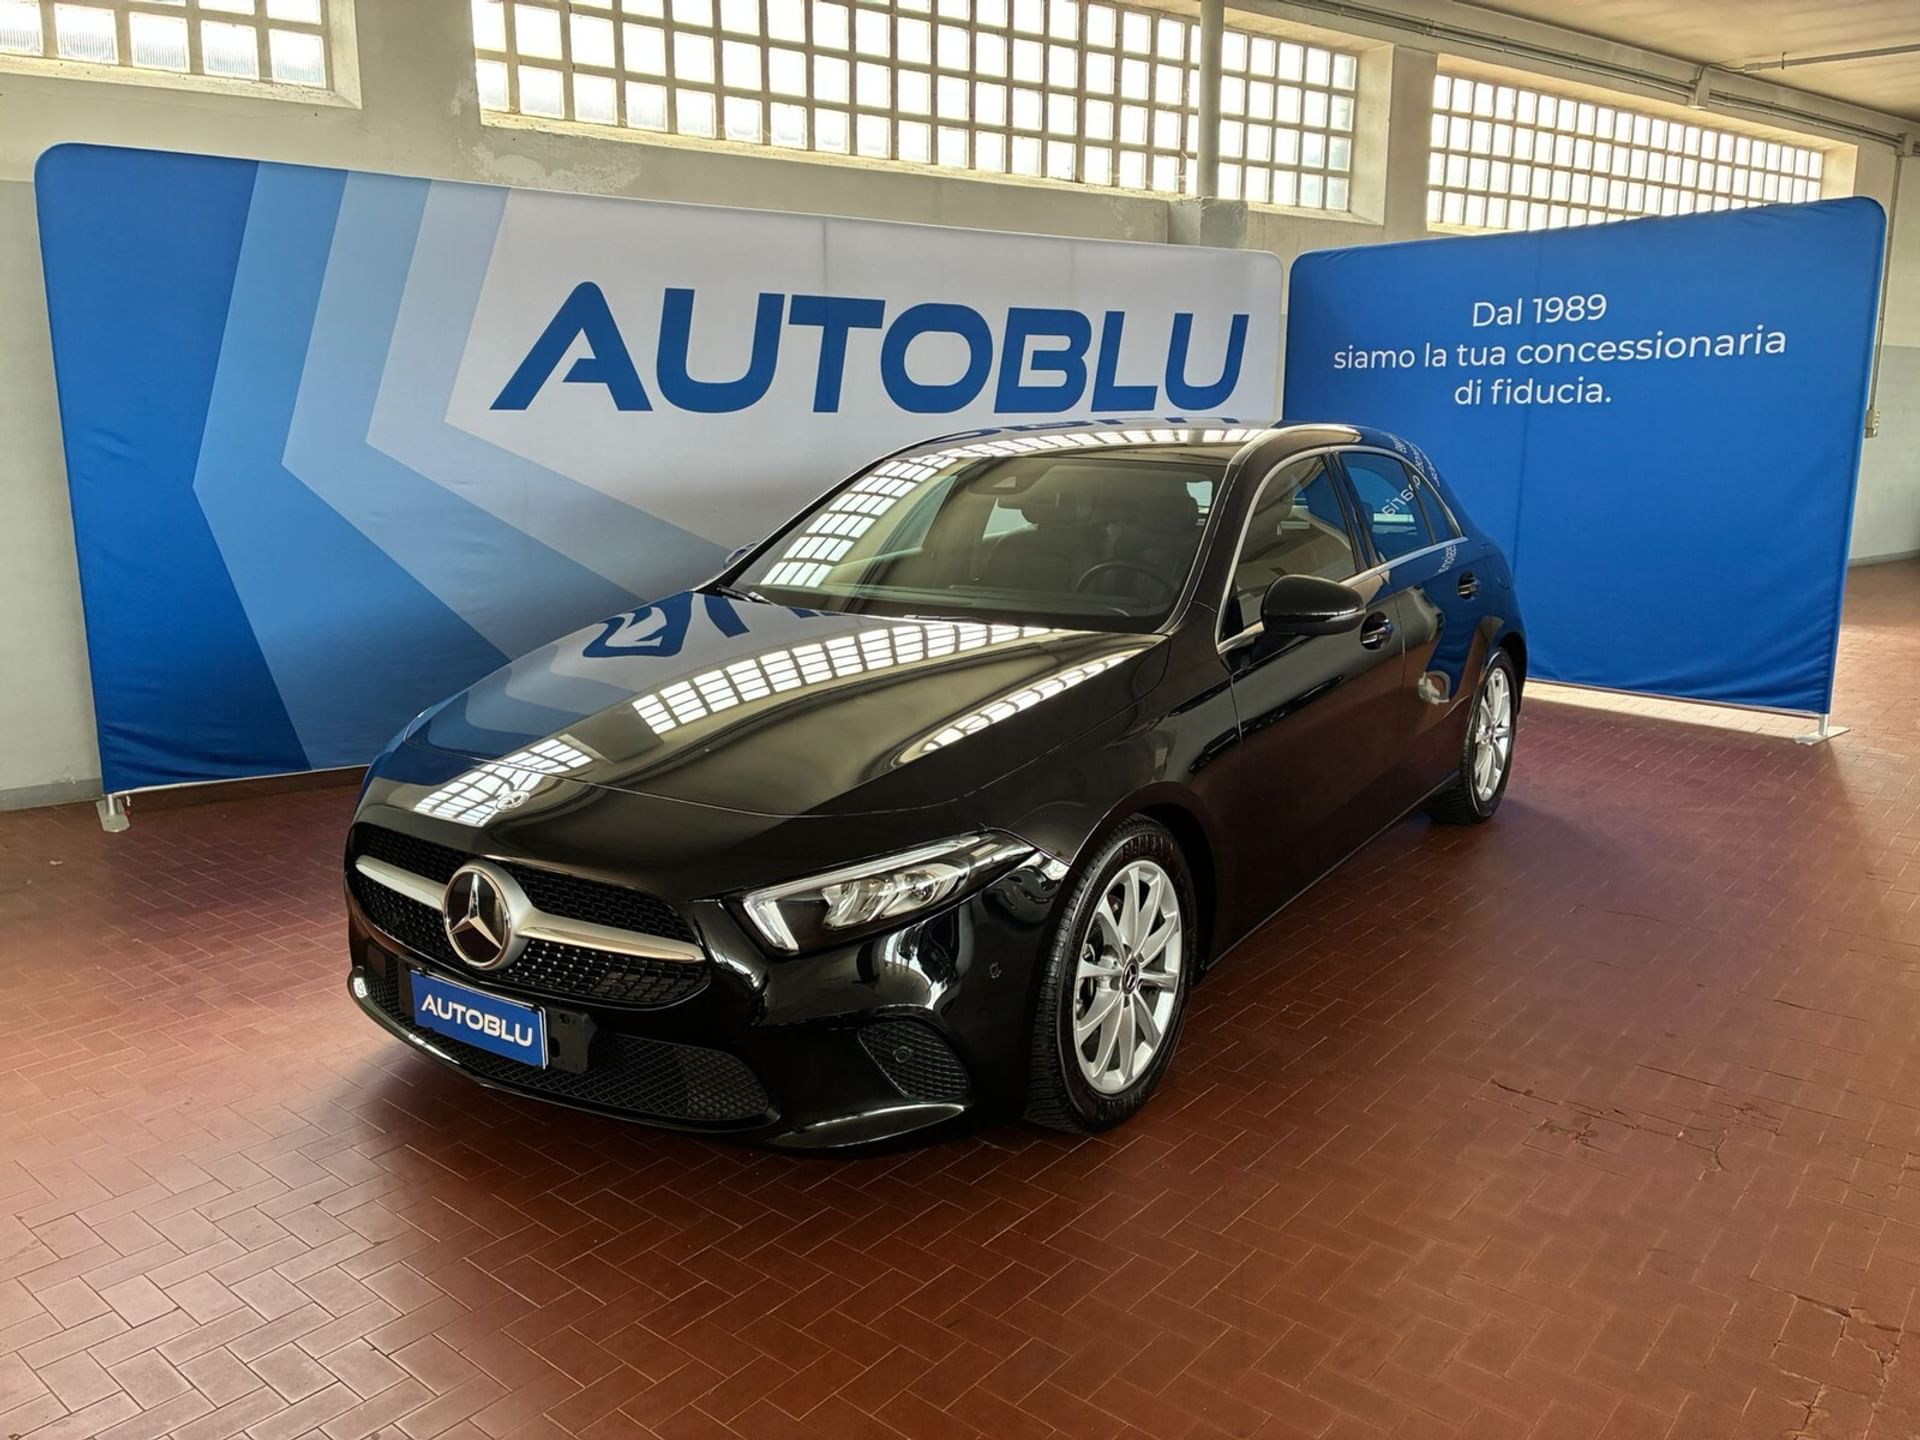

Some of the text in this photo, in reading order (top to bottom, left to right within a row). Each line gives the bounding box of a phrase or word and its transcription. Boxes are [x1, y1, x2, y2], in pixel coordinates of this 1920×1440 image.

[1472, 293, 1607, 328] Dal 1989
[489, 281, 1249, 414] AUTOBLU
[1333, 324, 1787, 369] siamo la tua concessionaria
[1454, 375, 1612, 405] di fiducia.
[421, 994, 533, 1047] AUTOBLU
